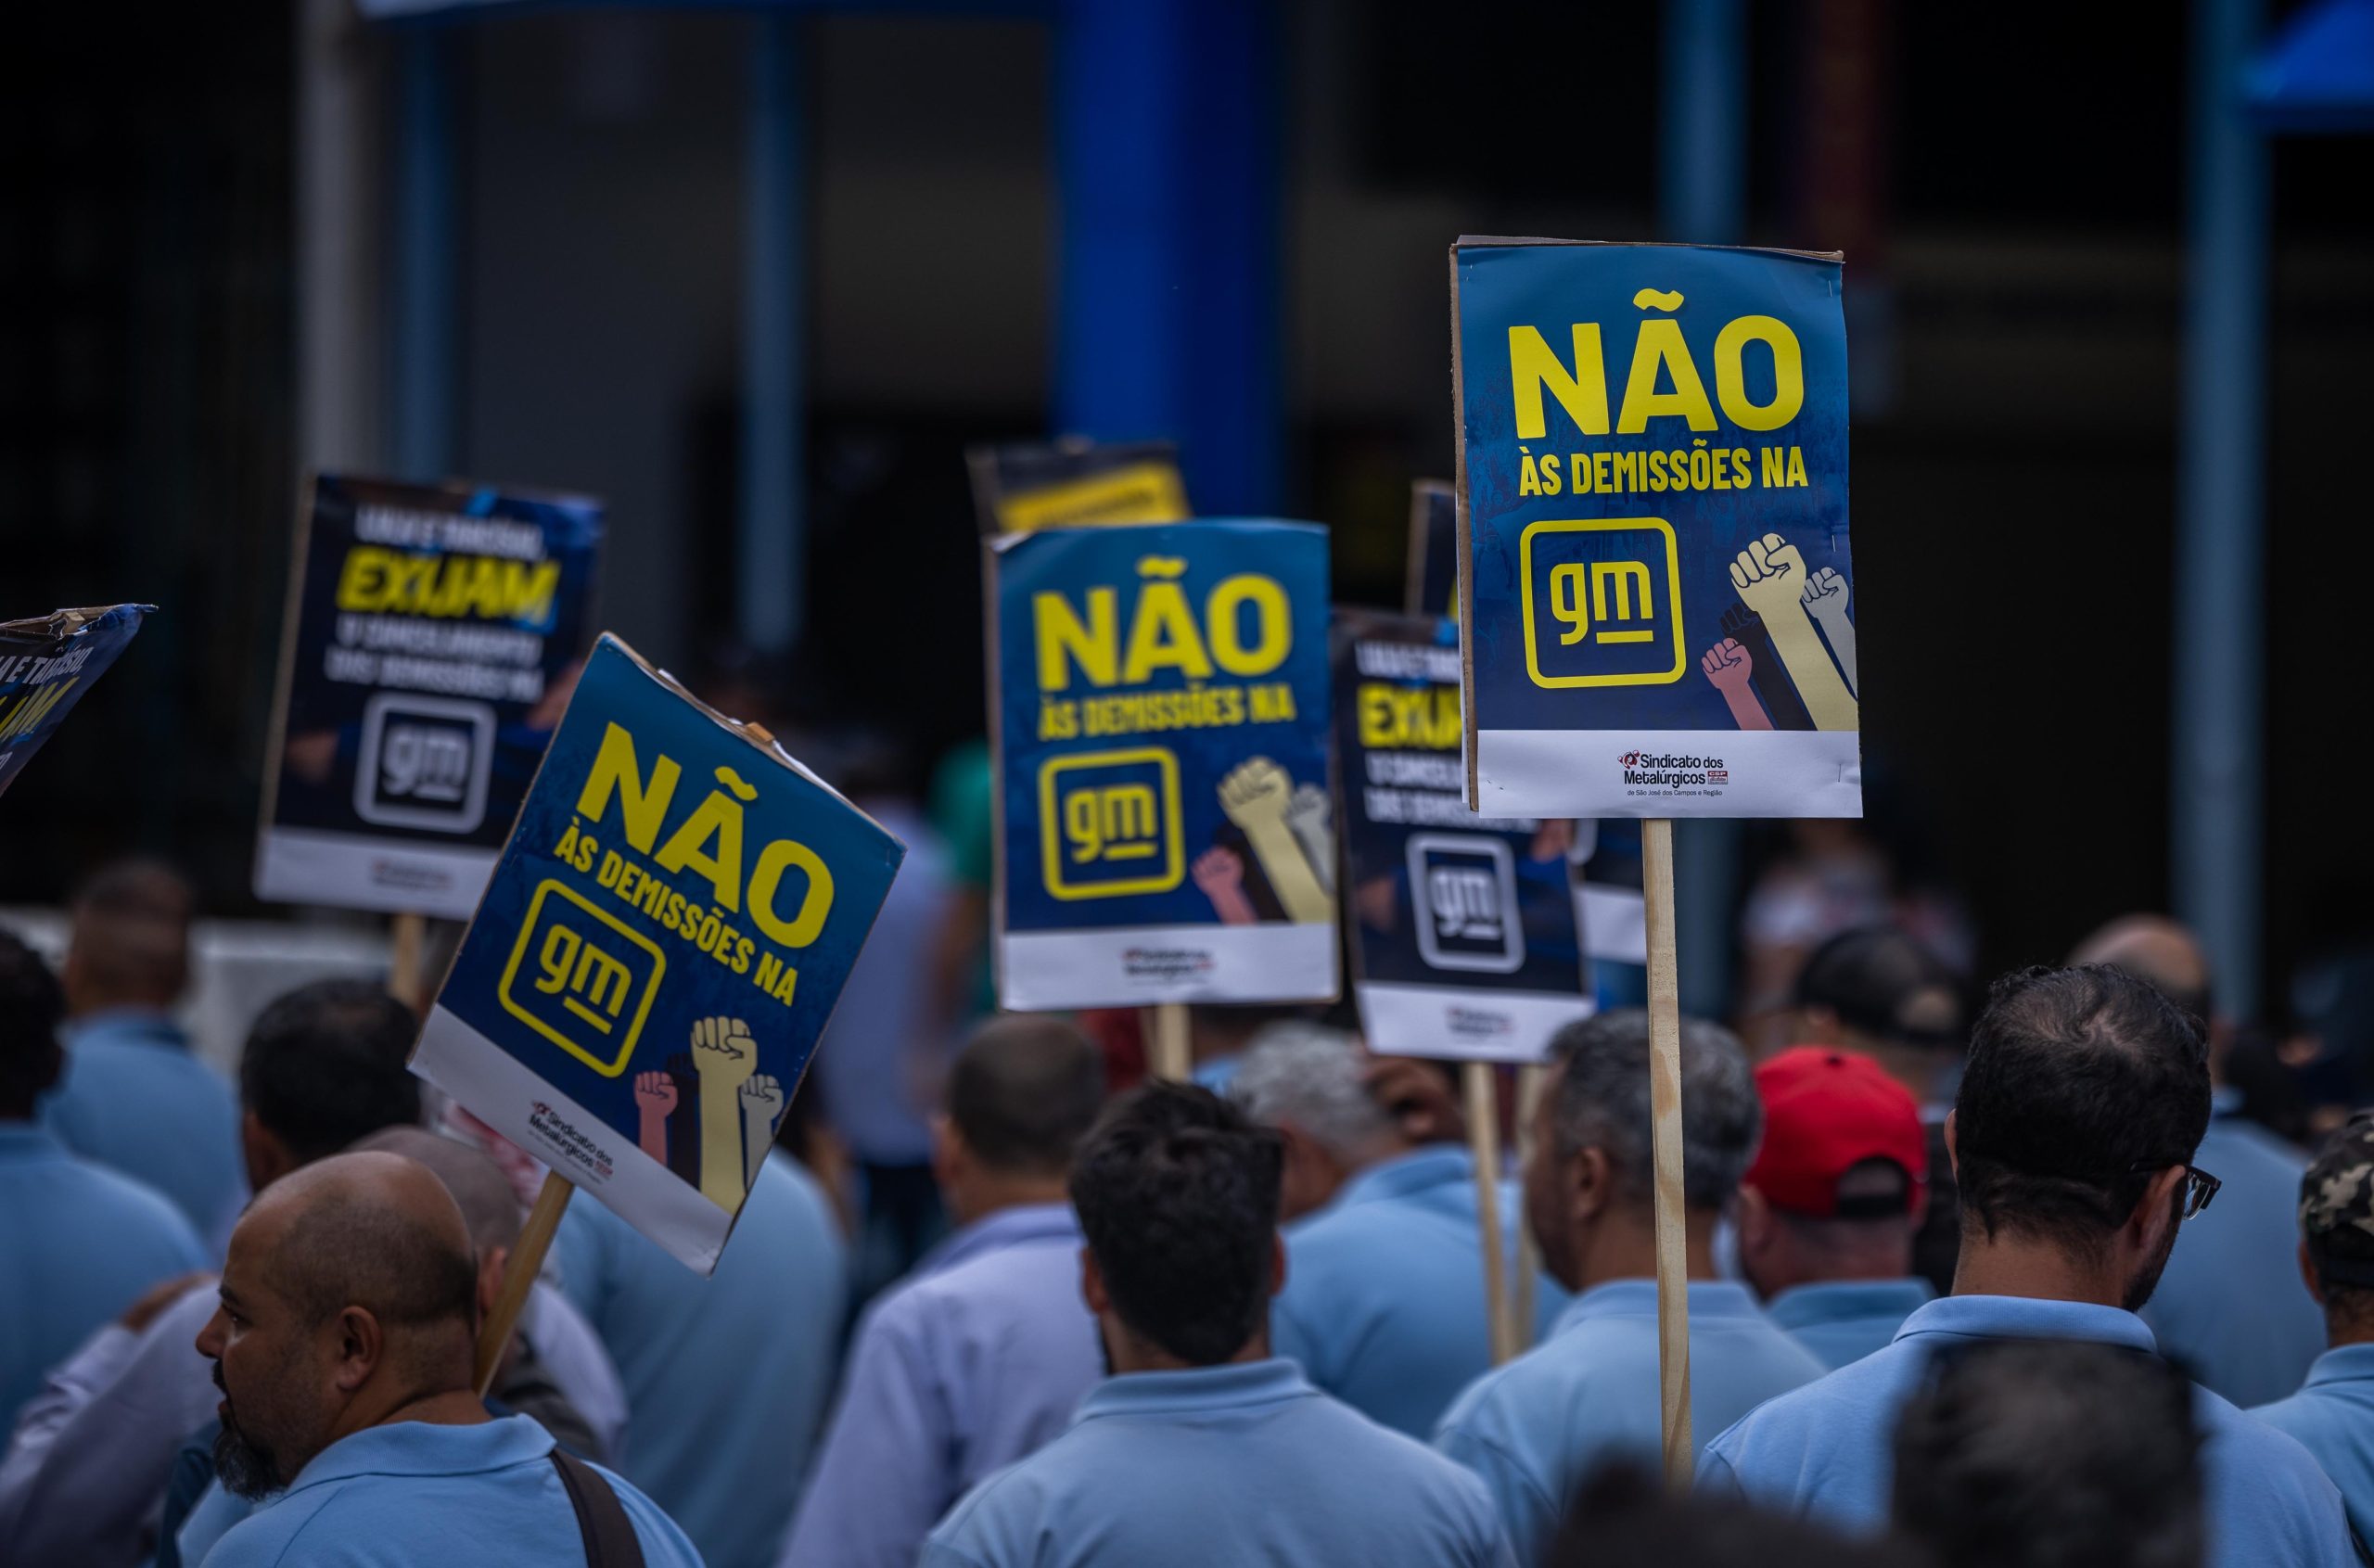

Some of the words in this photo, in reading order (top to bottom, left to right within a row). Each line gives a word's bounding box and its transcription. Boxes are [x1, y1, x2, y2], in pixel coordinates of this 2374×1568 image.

[1509, 288, 1804, 439] NÃO
[1520, 446, 1561, 496] ÀS
[1571, 439, 1752, 495] DEMISSÕES
[1762, 446, 1809, 489] NA
[1034, 556, 1293, 692] NÃO
[1550, 561, 1654, 645] gm
[5, 656, 33, 682] E
[1039, 693, 1079, 741] ÀS
[1082, 682, 1244, 737] DEMISSÕES
[1249, 682, 1296, 723] NA
[382, 723, 470, 803] gm
[1624, 770, 1706, 788] Metalúrgicos
[1640, 754, 1702, 769] Sindicato
[1703, 757, 1724, 769] dos
[1674, 789, 1697, 797] Campos
[1704, 789, 1723, 797] Região
[576, 720, 835, 949] NÃO
[1066, 785, 1158, 863] gm
[554, 816, 598, 872] ÀS
[596, 849, 756, 975] DEMISSÕES
[753, 950, 798, 1007] NA
[535, 924, 632, 1034] gm
[548, 1112, 596, 1154] Sindicato
[595, 1150, 613, 1166] dos
